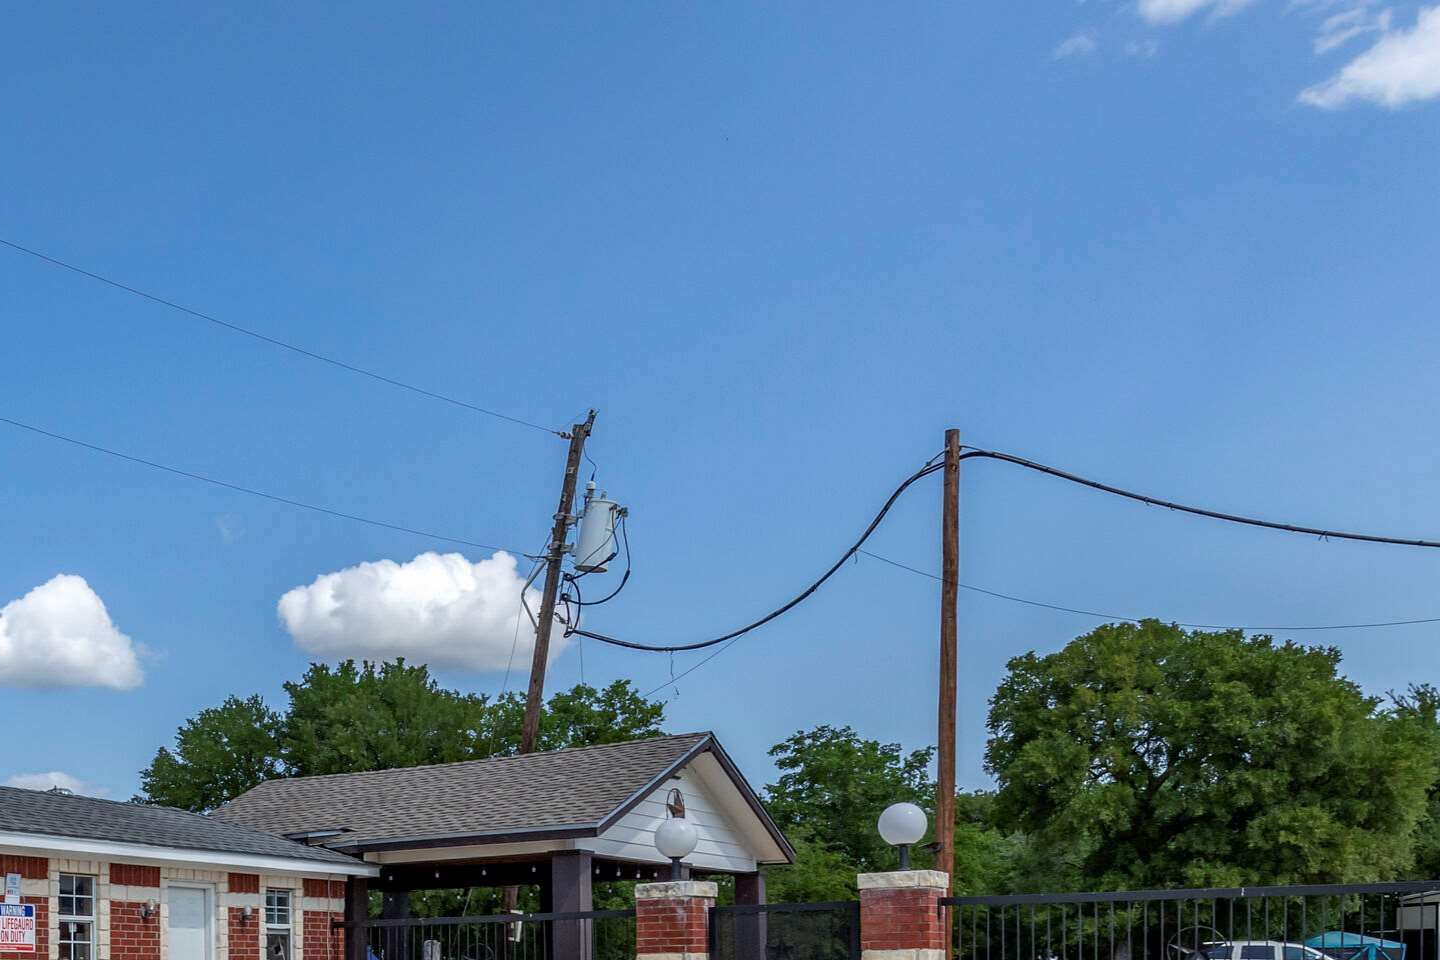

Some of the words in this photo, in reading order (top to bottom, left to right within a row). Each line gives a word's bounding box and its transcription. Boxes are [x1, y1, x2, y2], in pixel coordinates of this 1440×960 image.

[0, 905, 26, 917] WARNING
[2, 917, 33, 930] LIFEGAURD
[1, 930, 9, 942] ON
[10, 930, 25, 942] DUTY
